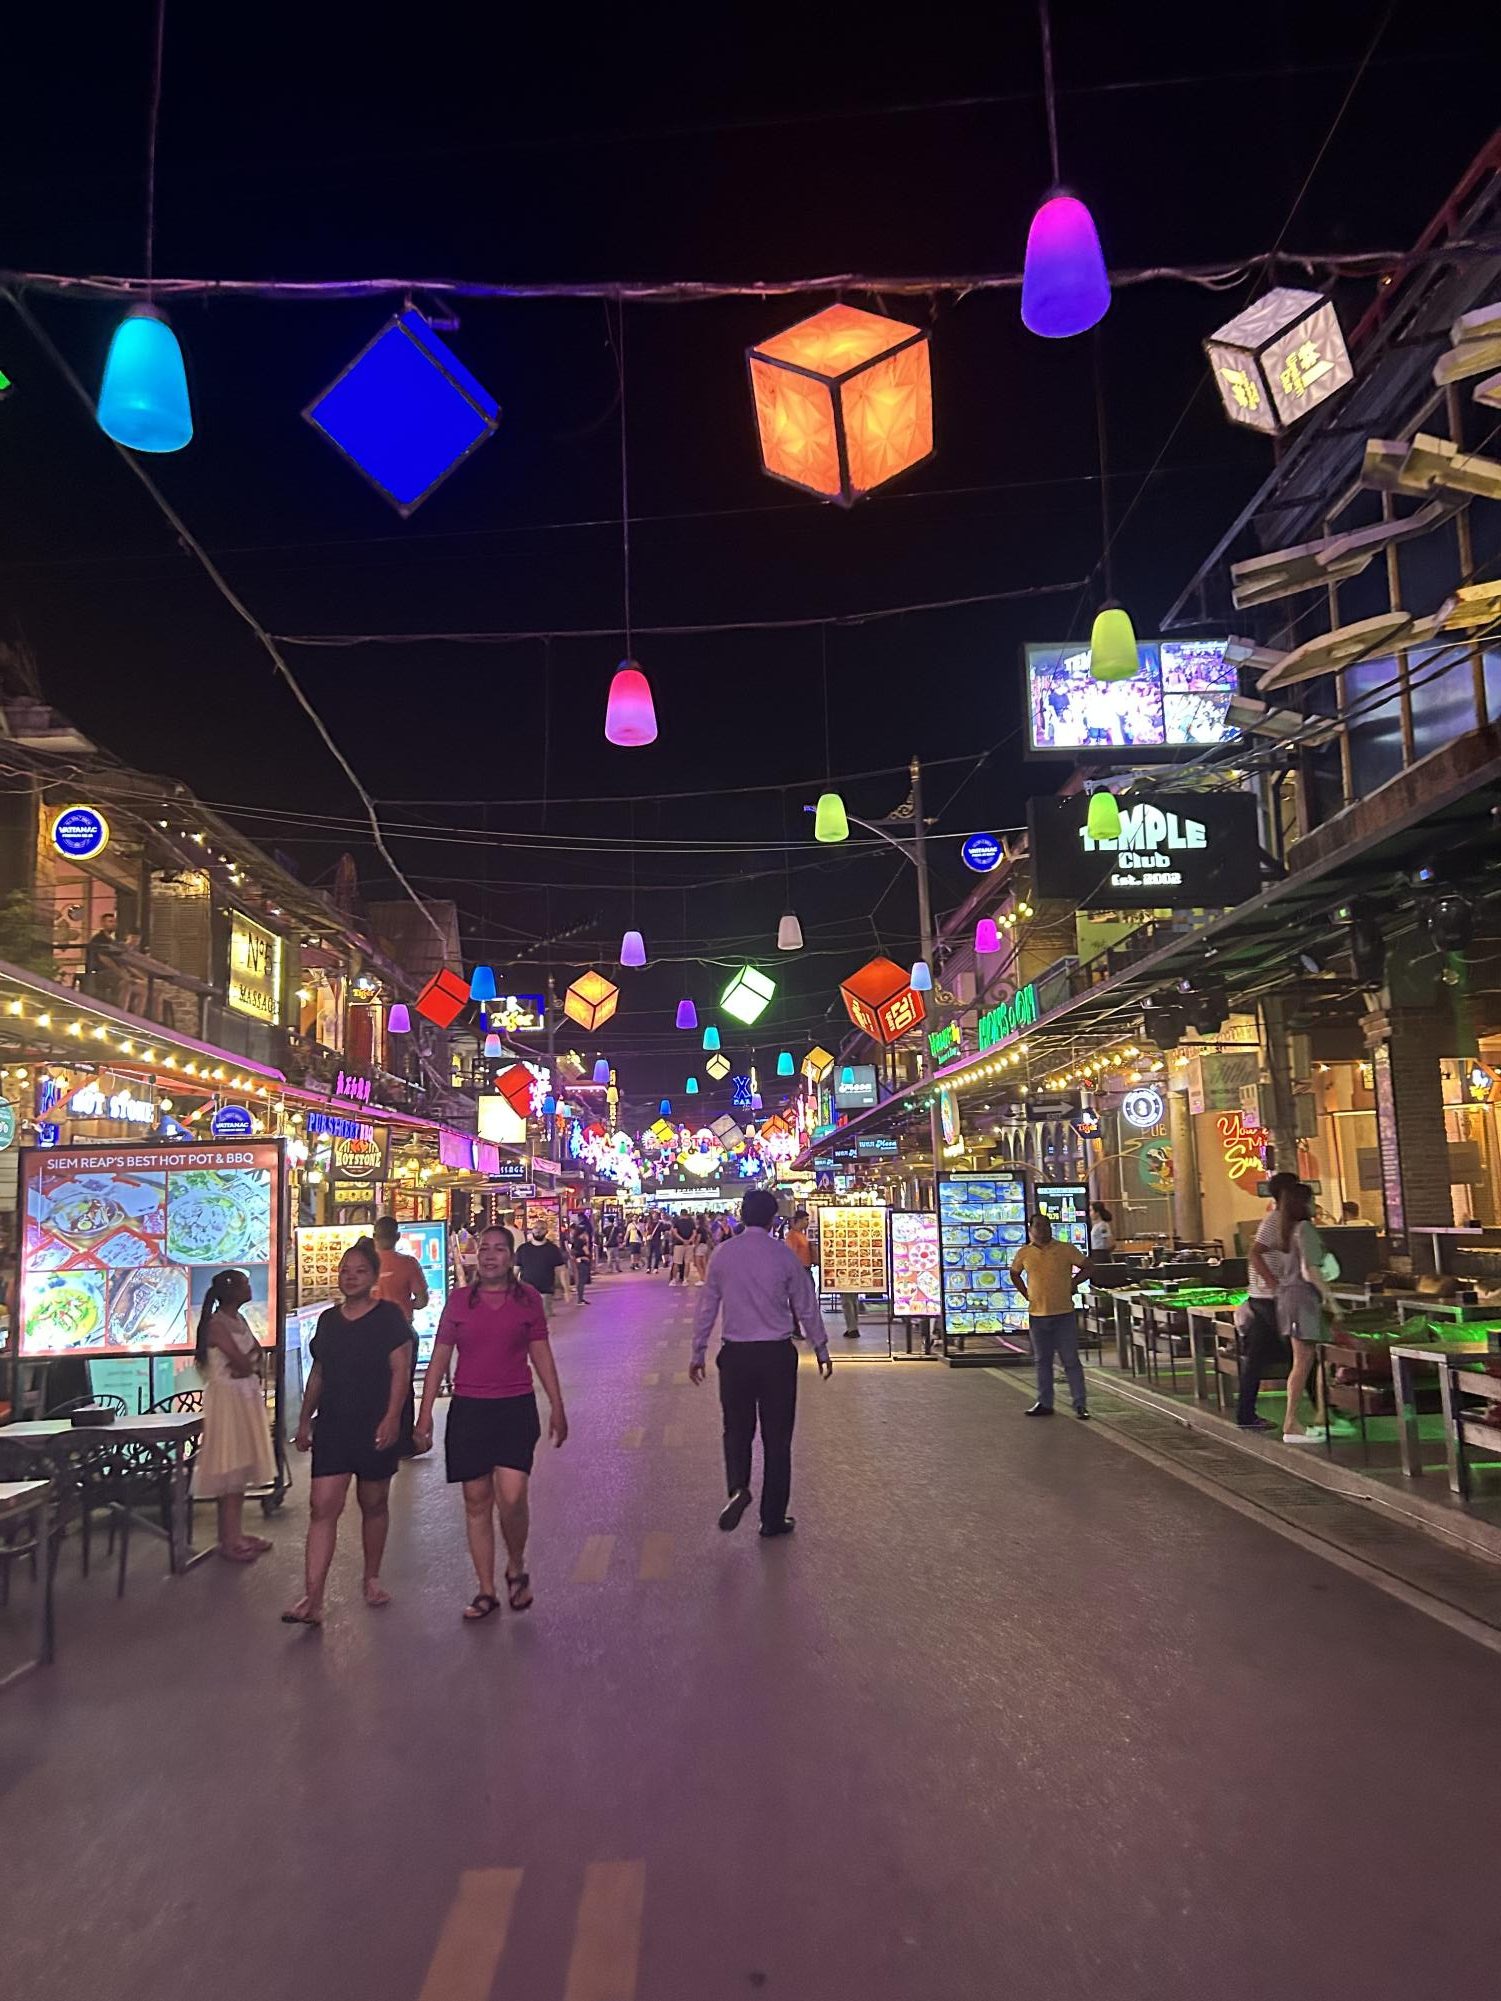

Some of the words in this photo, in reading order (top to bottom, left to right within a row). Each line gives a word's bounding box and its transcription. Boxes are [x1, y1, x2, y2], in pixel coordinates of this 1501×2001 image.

[1118, 852, 1171, 869] Club
[1111, 874, 1142, 886] Est.
[1142, 872, 1182, 886] 2002
[47, 1158, 78, 1170] SIEM
[80, 1156, 125, 1169] REAP'S
[126, 1154, 157, 1168] BEST
[159, 1154, 186, 1166] HOT
[188, 1153, 214, 1165] POT
[215, 1153, 224, 1164] &
[226, 1152, 254, 1164] BBQ
